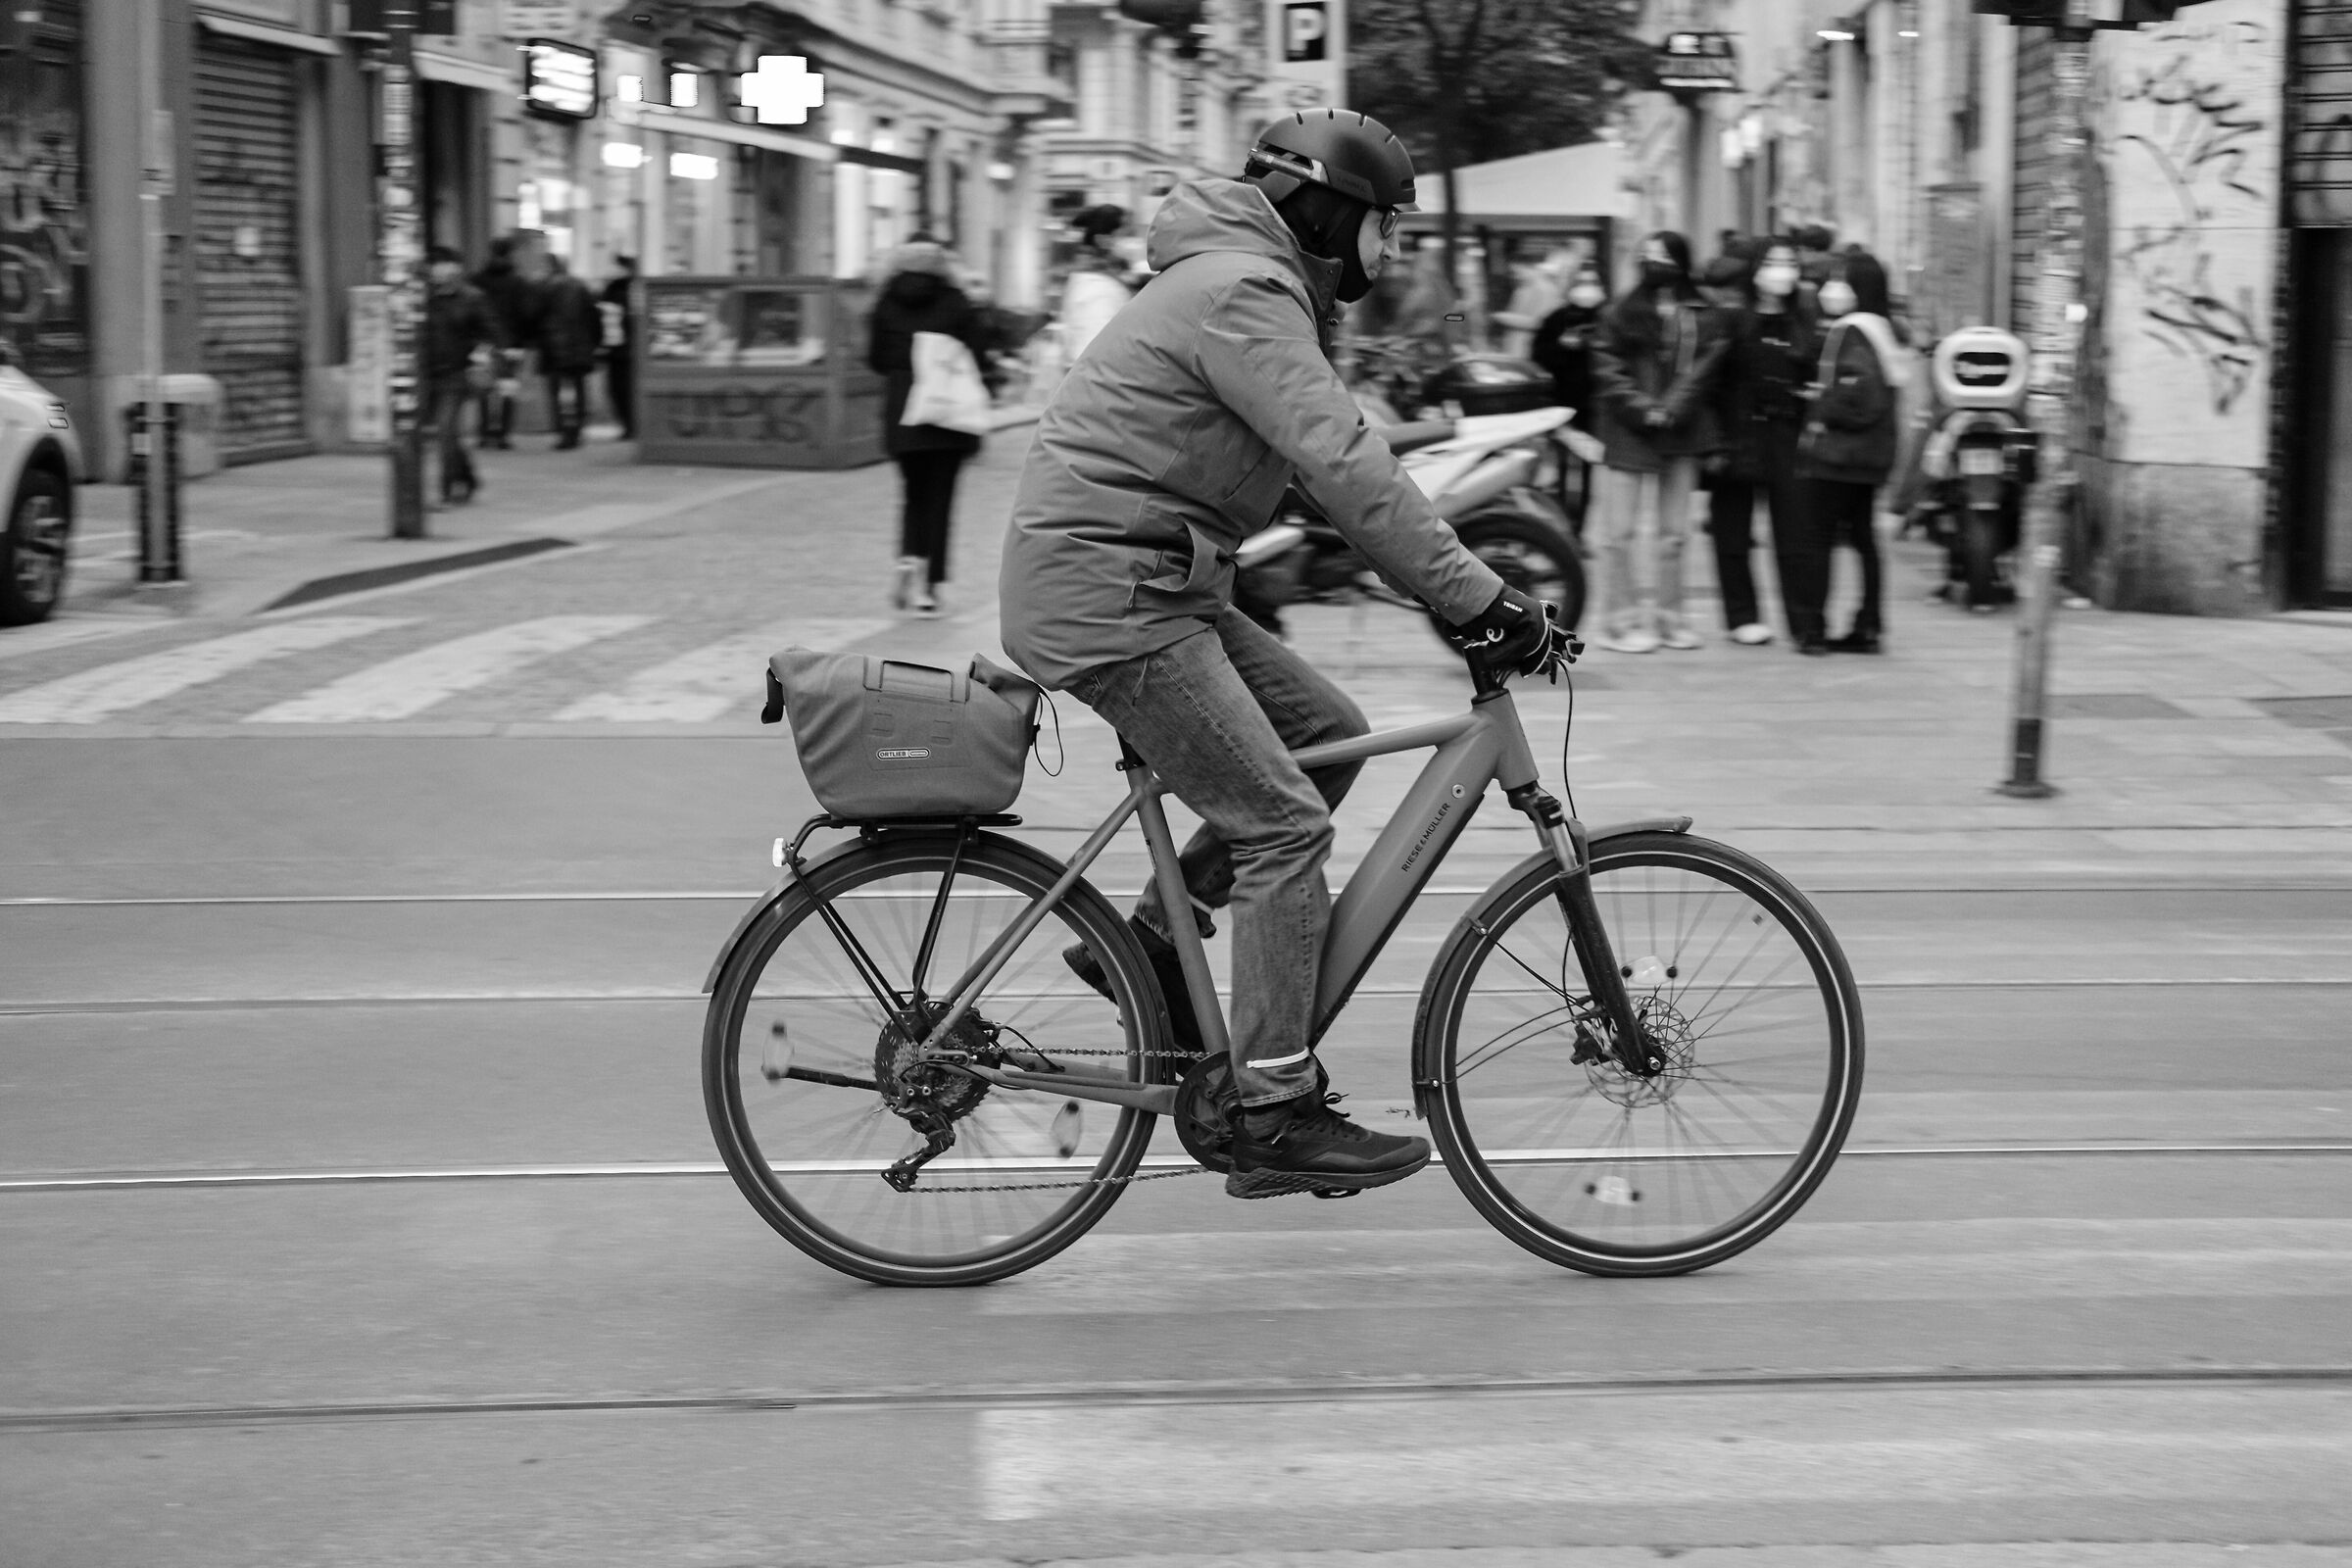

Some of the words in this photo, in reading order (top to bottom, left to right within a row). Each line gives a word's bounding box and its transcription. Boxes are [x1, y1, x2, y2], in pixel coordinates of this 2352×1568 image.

[1289, 8, 1324, 54] P
[1401, 844, 1423, 872] RIESE
[1422, 803, 1451, 840] MÜLLER
